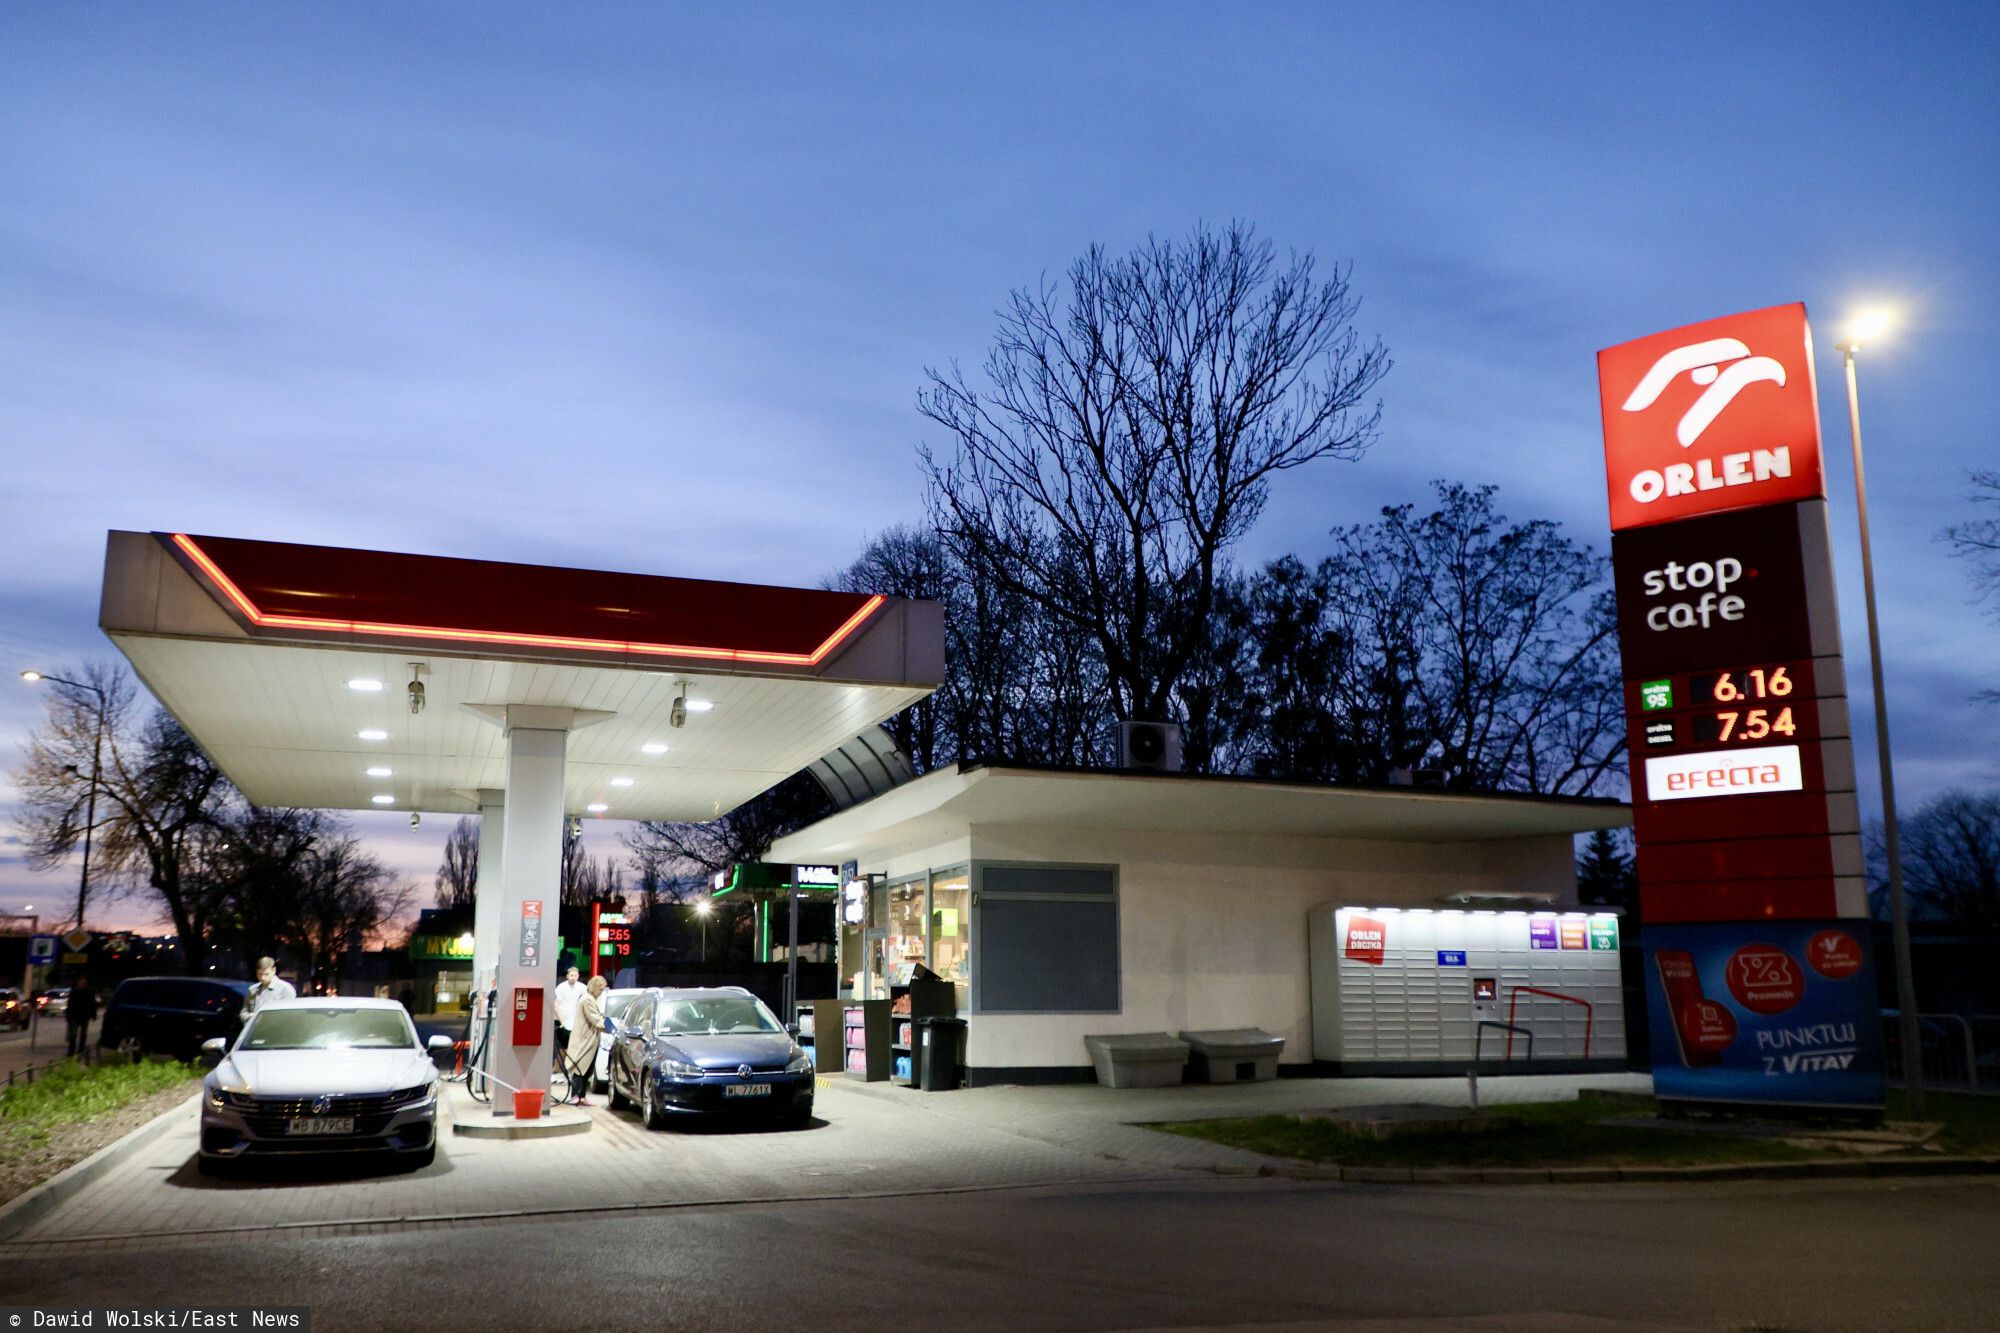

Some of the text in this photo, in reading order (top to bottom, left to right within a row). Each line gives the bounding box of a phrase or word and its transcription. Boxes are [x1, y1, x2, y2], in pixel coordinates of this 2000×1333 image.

[1630, 446, 1791, 503] ORLEN
[1643, 557, 1742, 596] stop
[1646, 592, 1745, 631] cafe
[1647, 693, 1667, 708] 95
[1714, 667, 1793, 701] 6.16
[1716, 707, 1796, 741] 7.54
[1757, 1024, 1856, 1049] PUNKTUJ
[1783, 1050, 1856, 1073] VITAY
